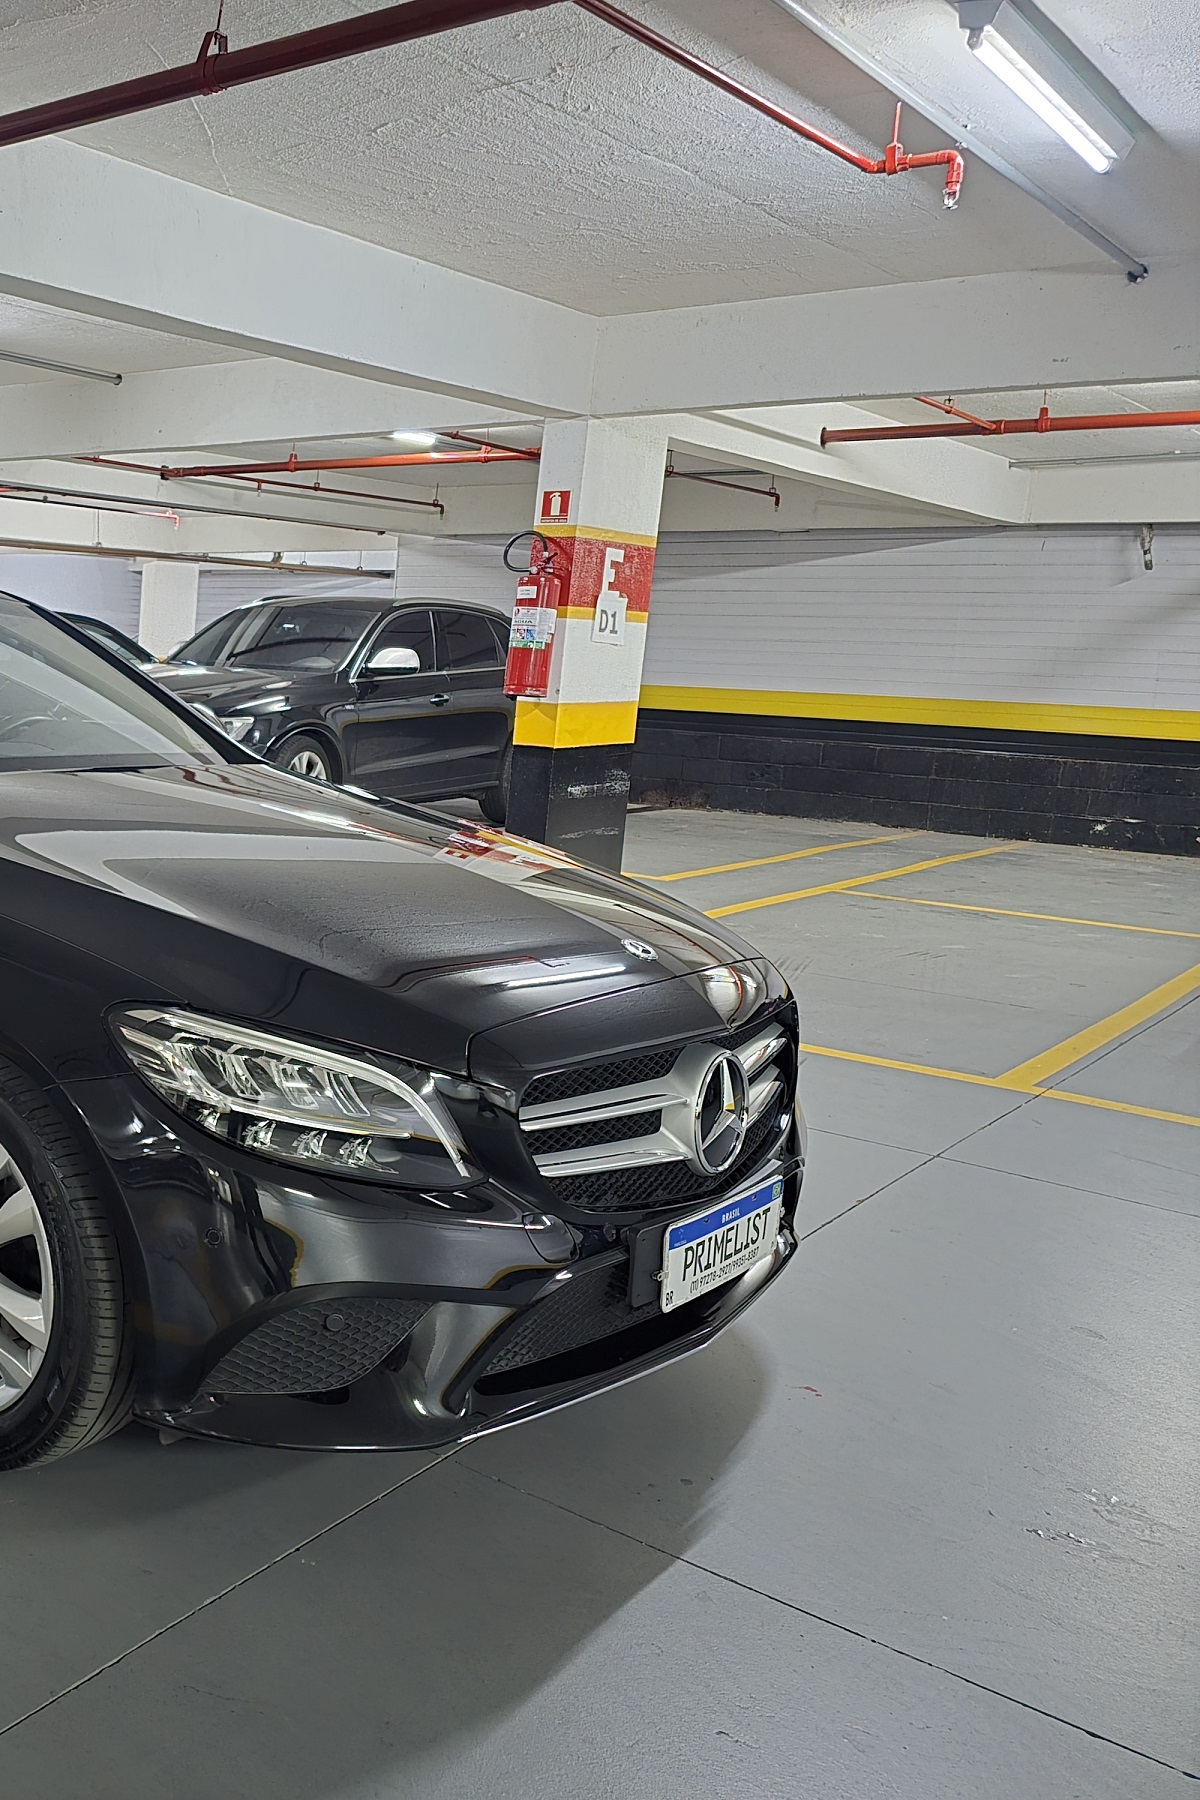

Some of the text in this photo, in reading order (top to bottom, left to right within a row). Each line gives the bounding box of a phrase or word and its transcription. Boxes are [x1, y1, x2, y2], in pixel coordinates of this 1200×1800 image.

[601, 547, 625, 598] E
[599, 609, 618, 634] D1
[721, 1207, 740, 1224] BRASIL
[682, 1207, 771, 1282] PRIMELIST
[665, 1290, 674, 1306] BR
